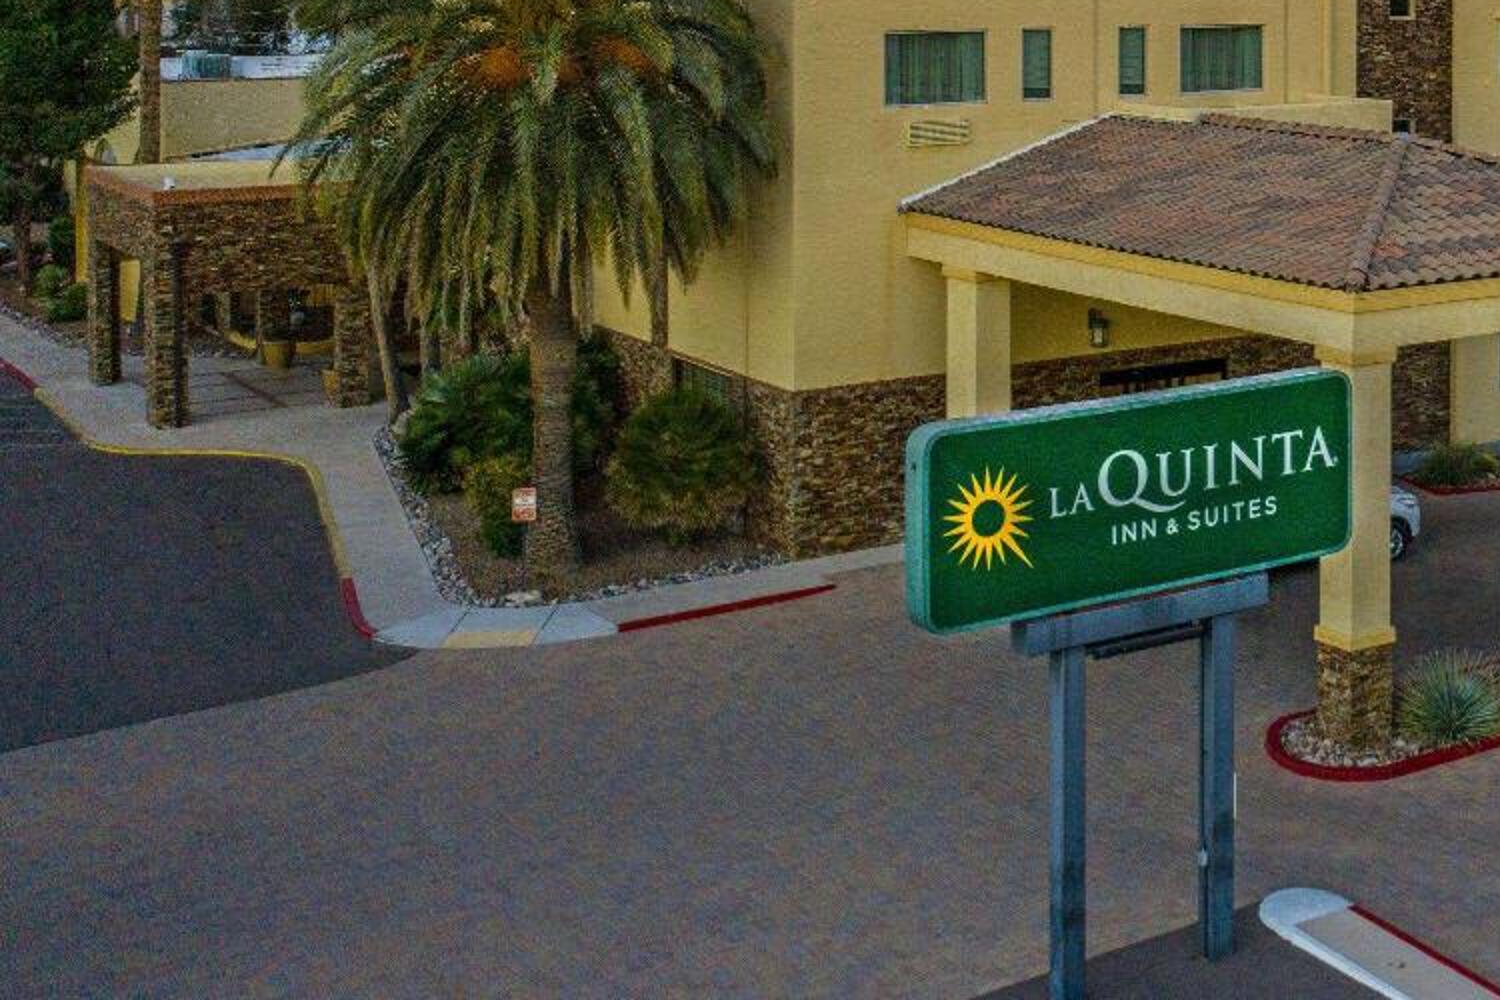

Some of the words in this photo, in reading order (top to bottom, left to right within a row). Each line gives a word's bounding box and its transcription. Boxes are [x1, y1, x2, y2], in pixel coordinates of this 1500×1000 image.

[1048, 481, 1094, 519] LA
[1097, 425, 1336, 513] QUINTA
[1111, 520, 1157, 546] INN
[1166, 518, 1180, 534] &
[1187, 496, 1278, 531] SUITES
